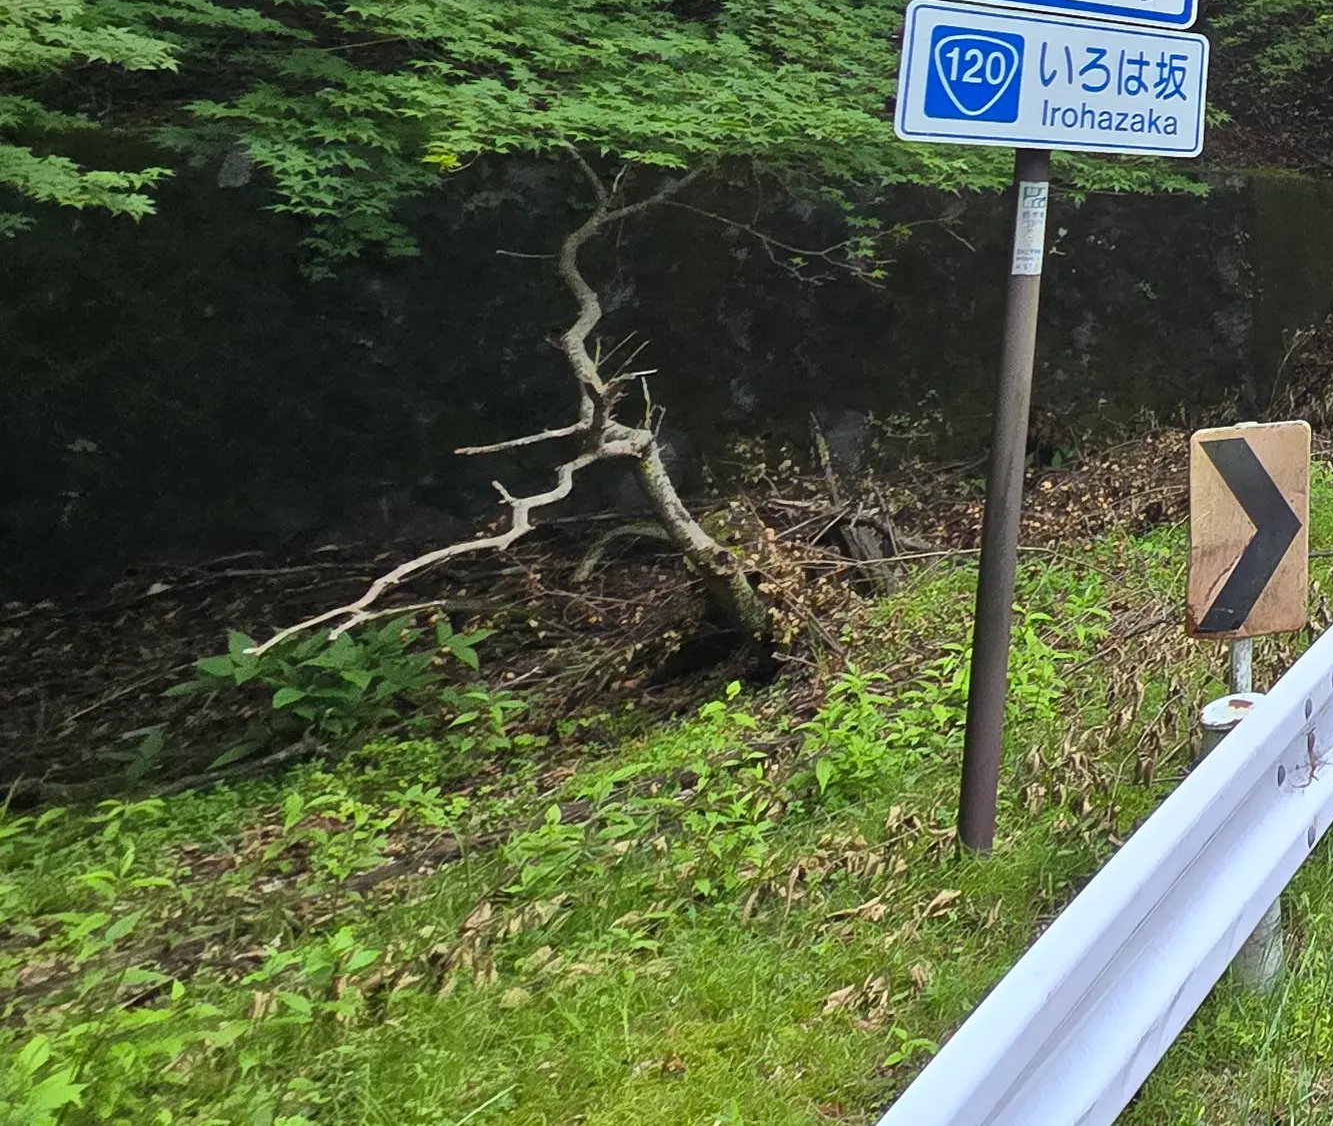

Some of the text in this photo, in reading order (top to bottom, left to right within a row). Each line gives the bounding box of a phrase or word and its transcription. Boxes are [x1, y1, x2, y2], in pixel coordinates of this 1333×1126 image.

[945, 48, 1007, 87] 120
[1039, 41, 1188, 102] いろは坂
[1041, 99, 1179, 137] Irohazaka
